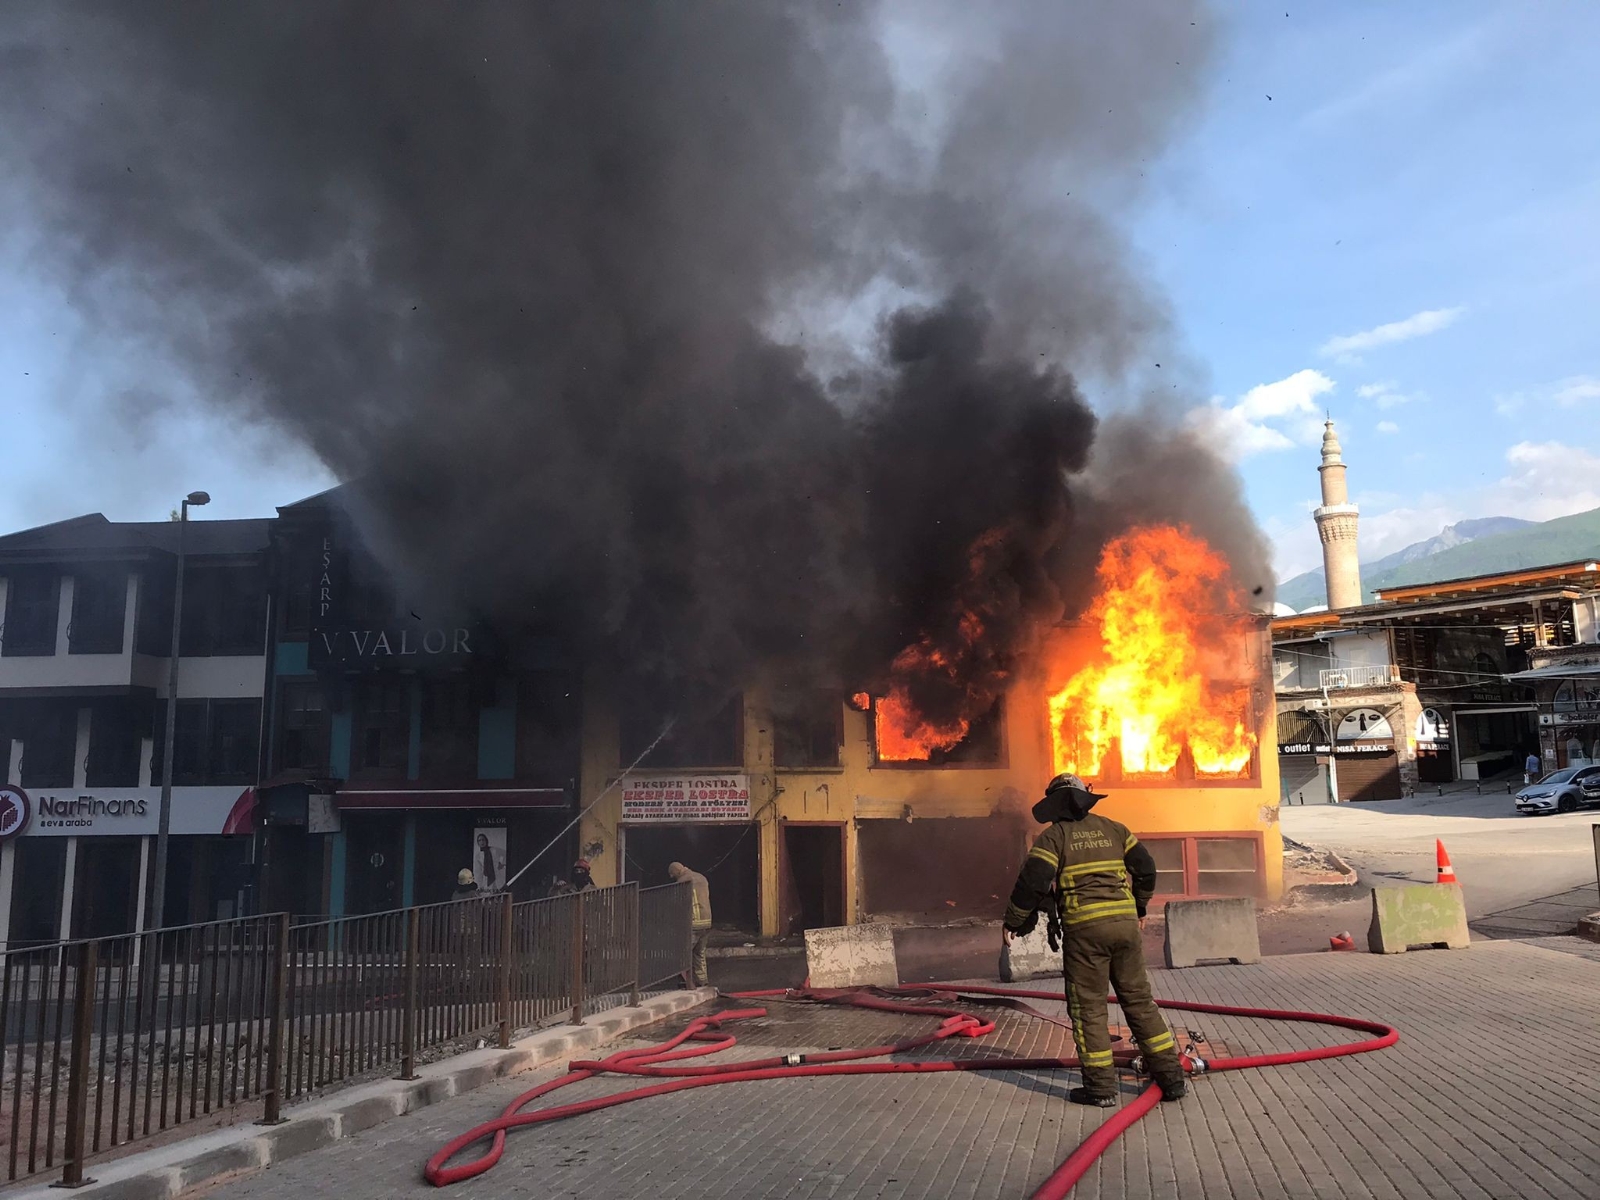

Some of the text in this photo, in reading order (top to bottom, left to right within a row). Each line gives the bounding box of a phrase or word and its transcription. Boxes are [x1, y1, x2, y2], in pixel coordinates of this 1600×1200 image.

[320, 537, 331, 616] EŞARP
[1285, 743, 1311, 753] outlet
[1357, 744, 1389, 752] FERACE
[623, 789, 749, 801] EKSPER LOSTRA
[39, 796, 148, 817] NarFinans
[65, 818, 93, 827] araba
[1072, 830, 1104, 839] BURSA
